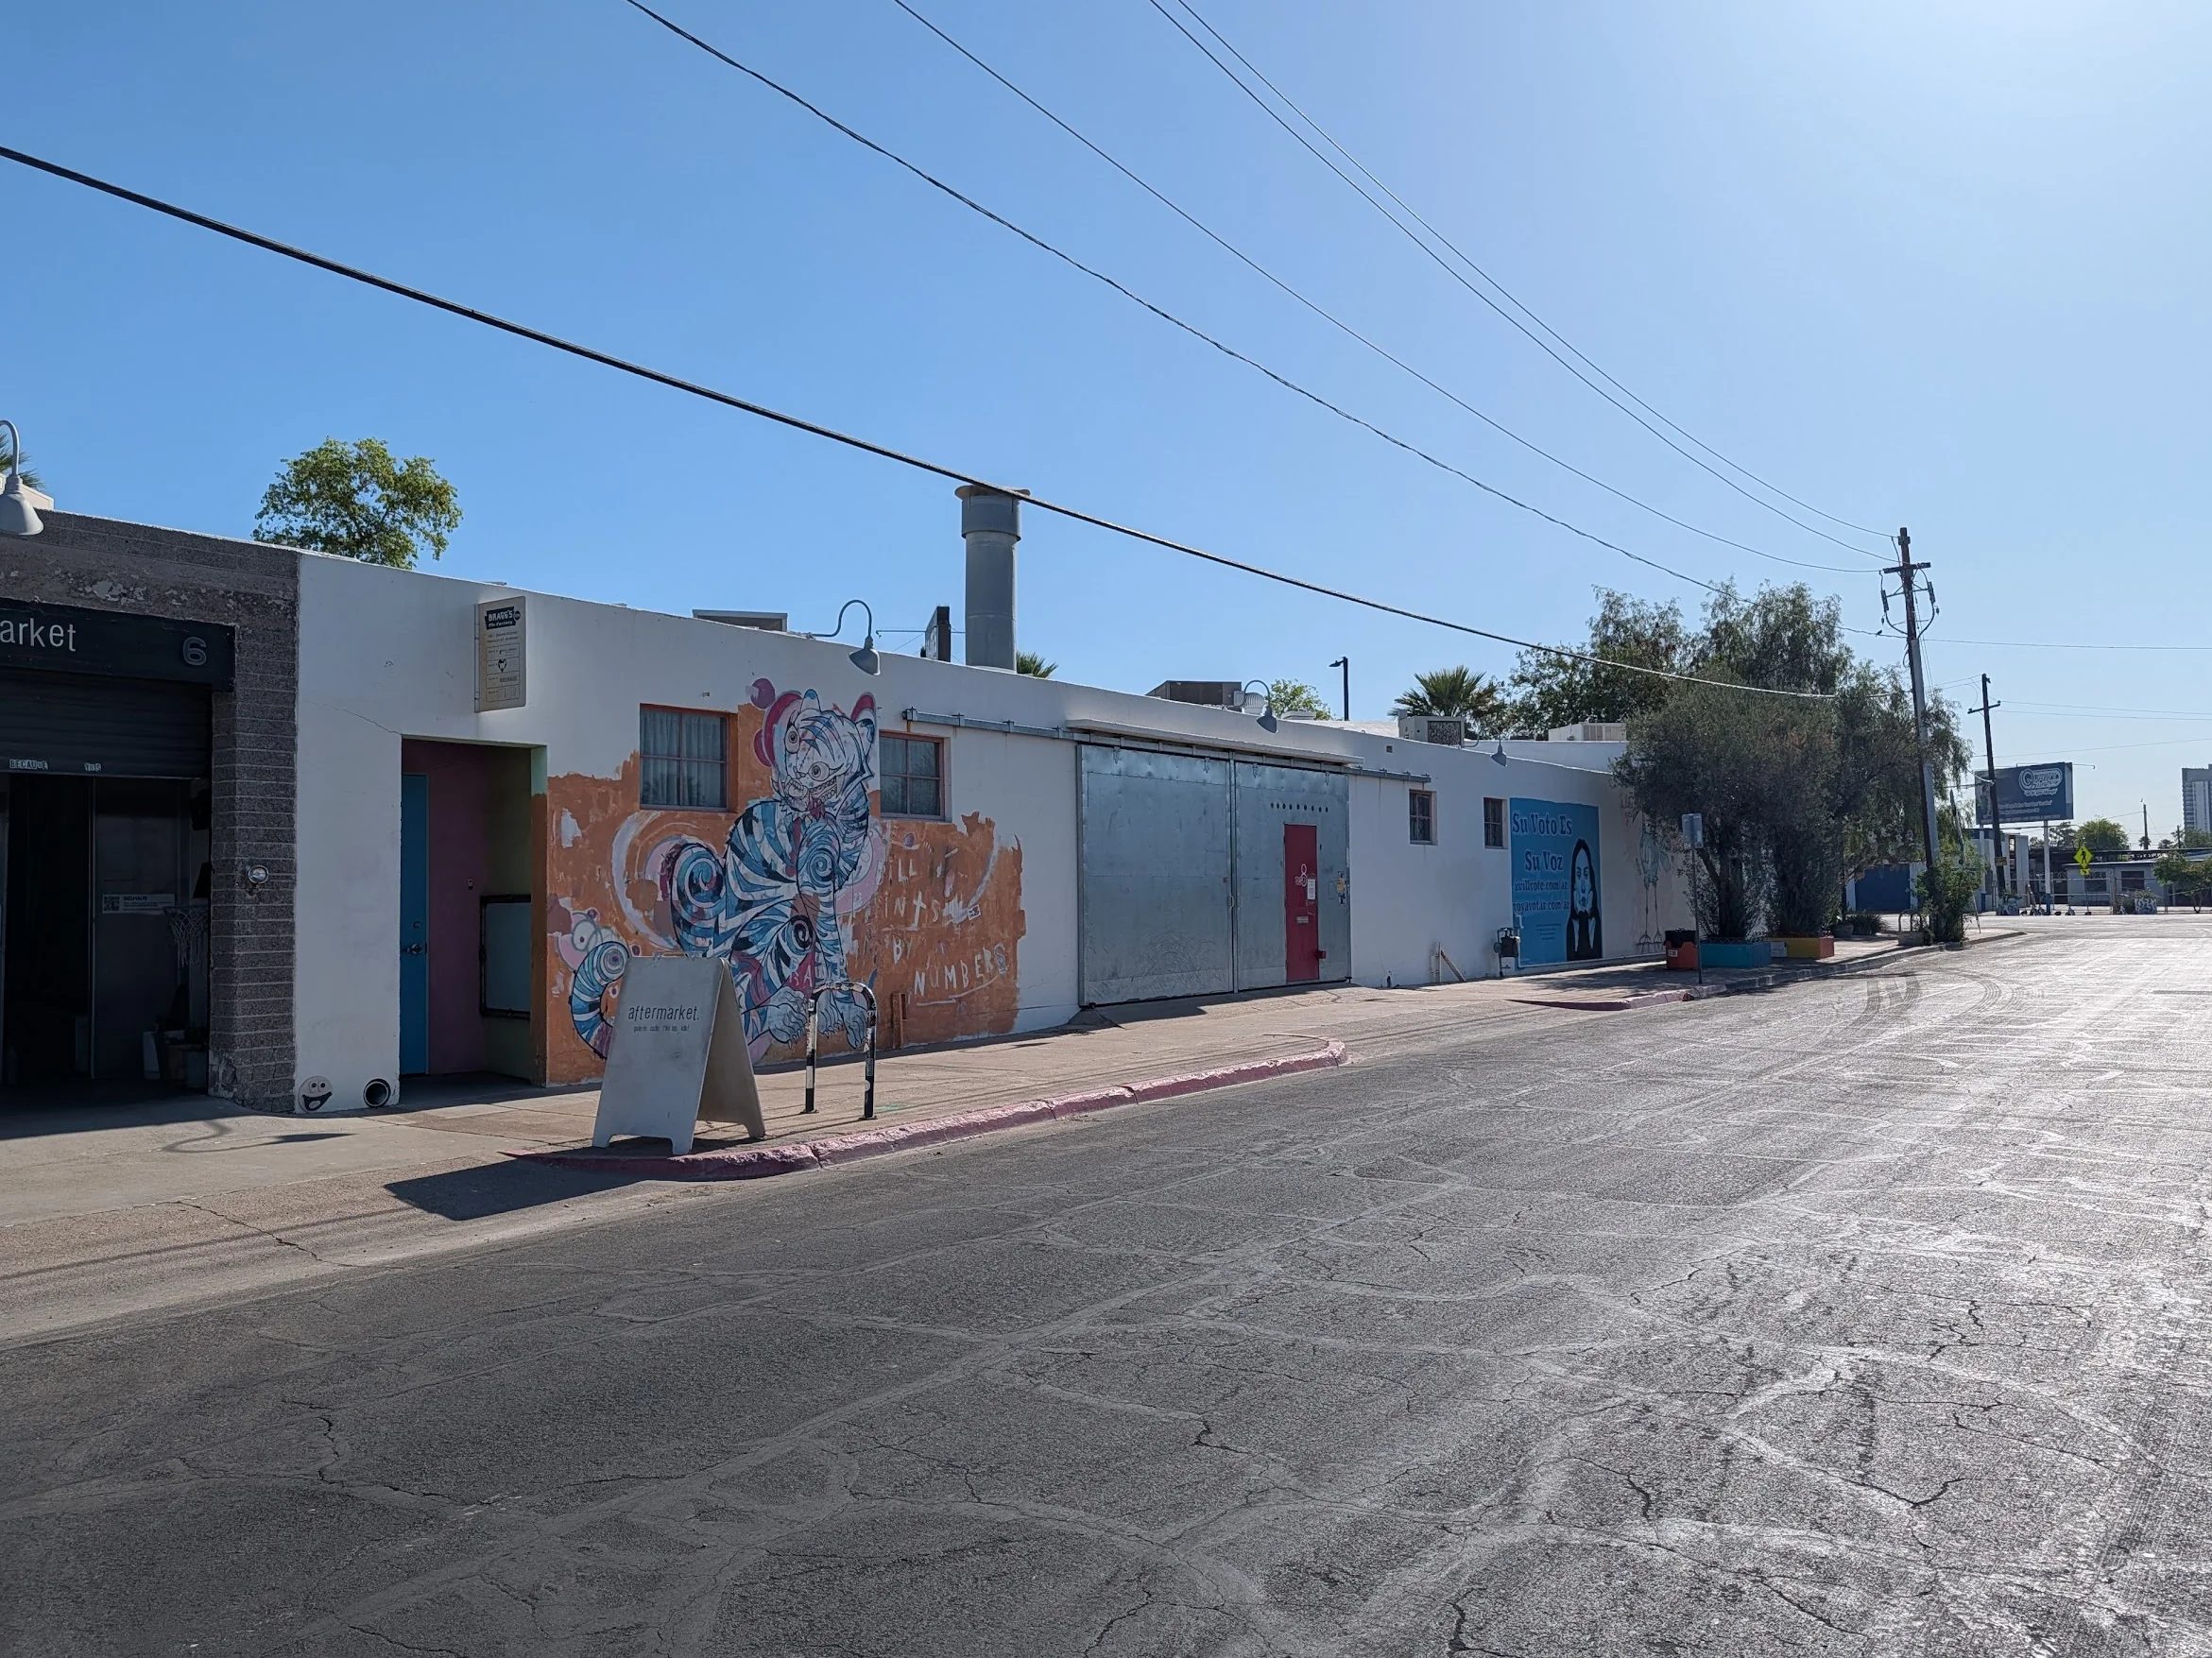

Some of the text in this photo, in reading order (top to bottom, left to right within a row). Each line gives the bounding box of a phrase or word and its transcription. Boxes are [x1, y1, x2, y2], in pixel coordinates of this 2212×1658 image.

[488, 609, 513, 622] BRAGG'S
[0, 618, 77, 652] arket
[182, 637, 207, 666] 6
[1512, 812, 1572, 835] Su Voto Es
[1525, 850, 1563, 871] Su Voz
[914, 944, 1007, 997] NUMBERS
[628, 1005, 699, 1021] aftermarket.
